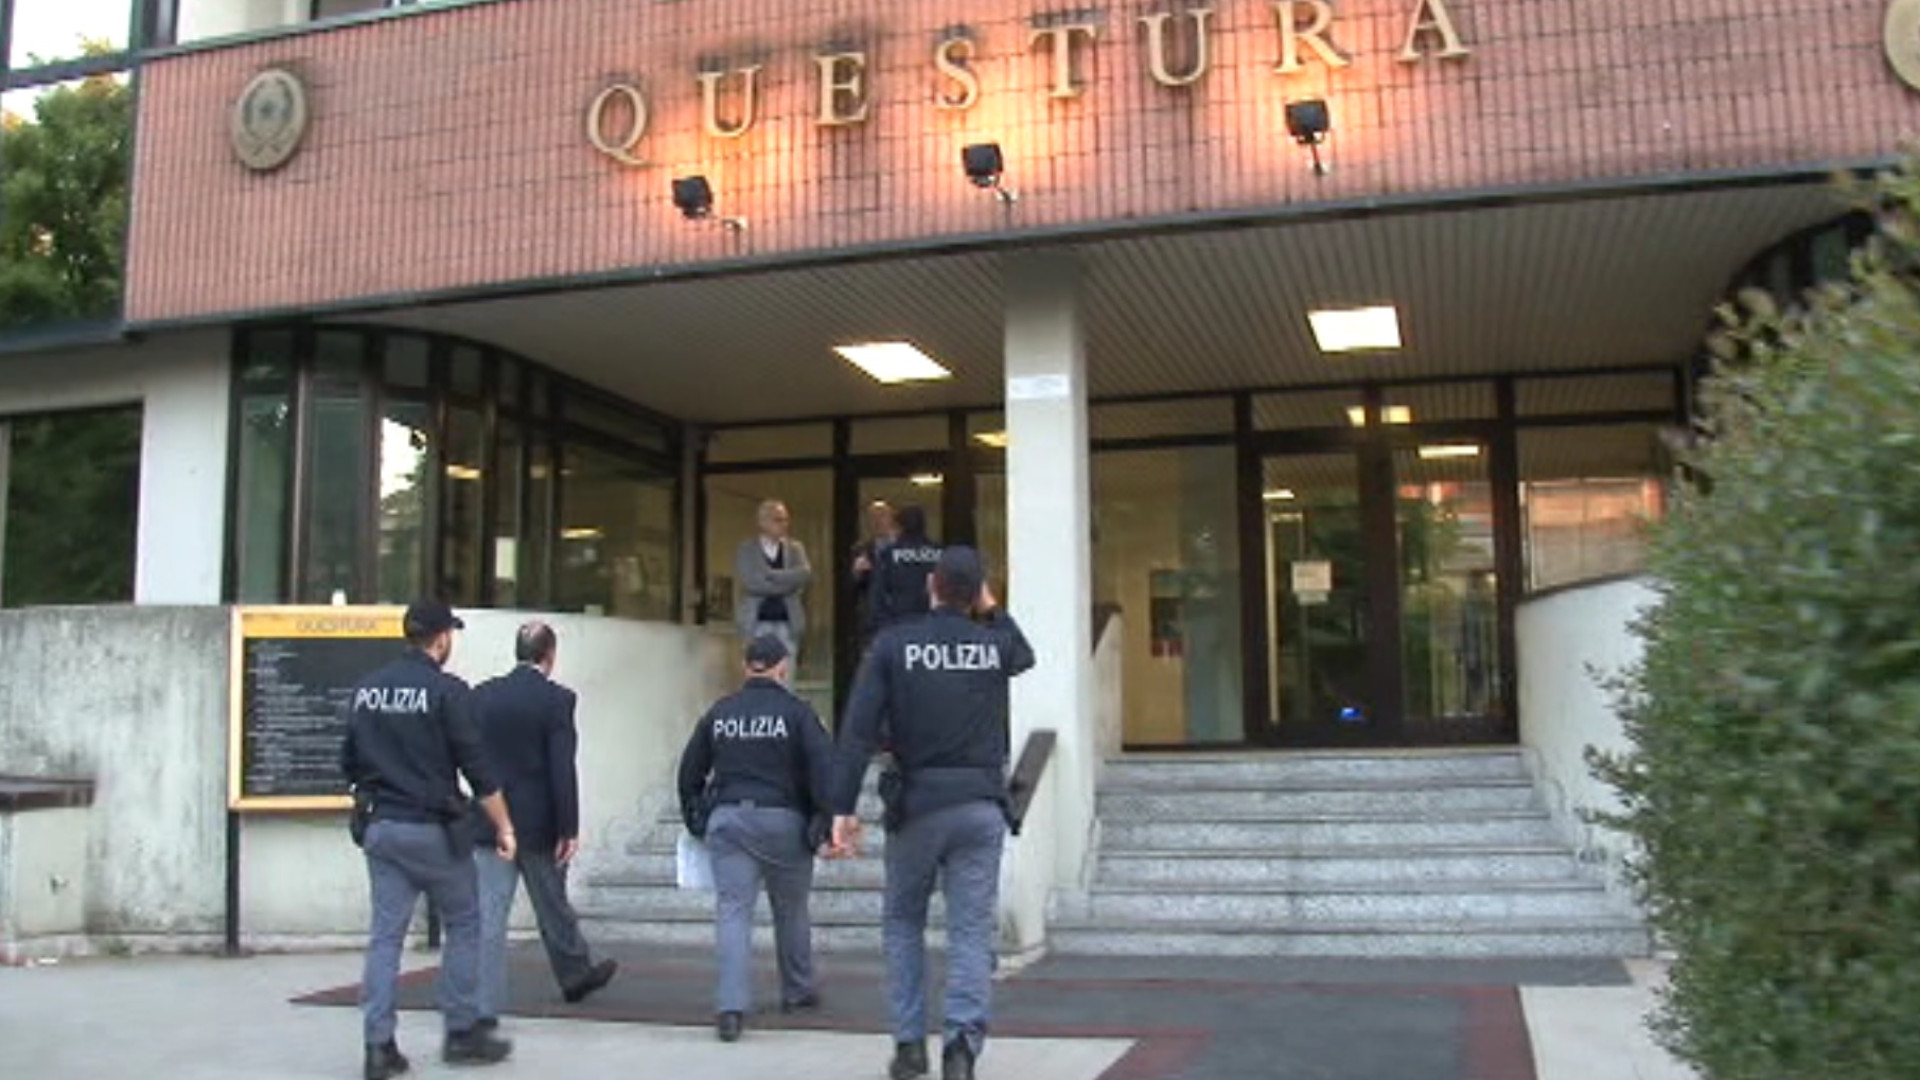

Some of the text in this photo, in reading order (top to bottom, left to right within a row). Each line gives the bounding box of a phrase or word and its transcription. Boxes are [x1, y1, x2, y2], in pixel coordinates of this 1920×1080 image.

[585, 0, 1471, 166] QUESTURA
[905, 643, 1001, 672] POLIZIA
[354, 686, 429, 713] POLIZIA
[713, 717, 788, 740] POLIZIA
